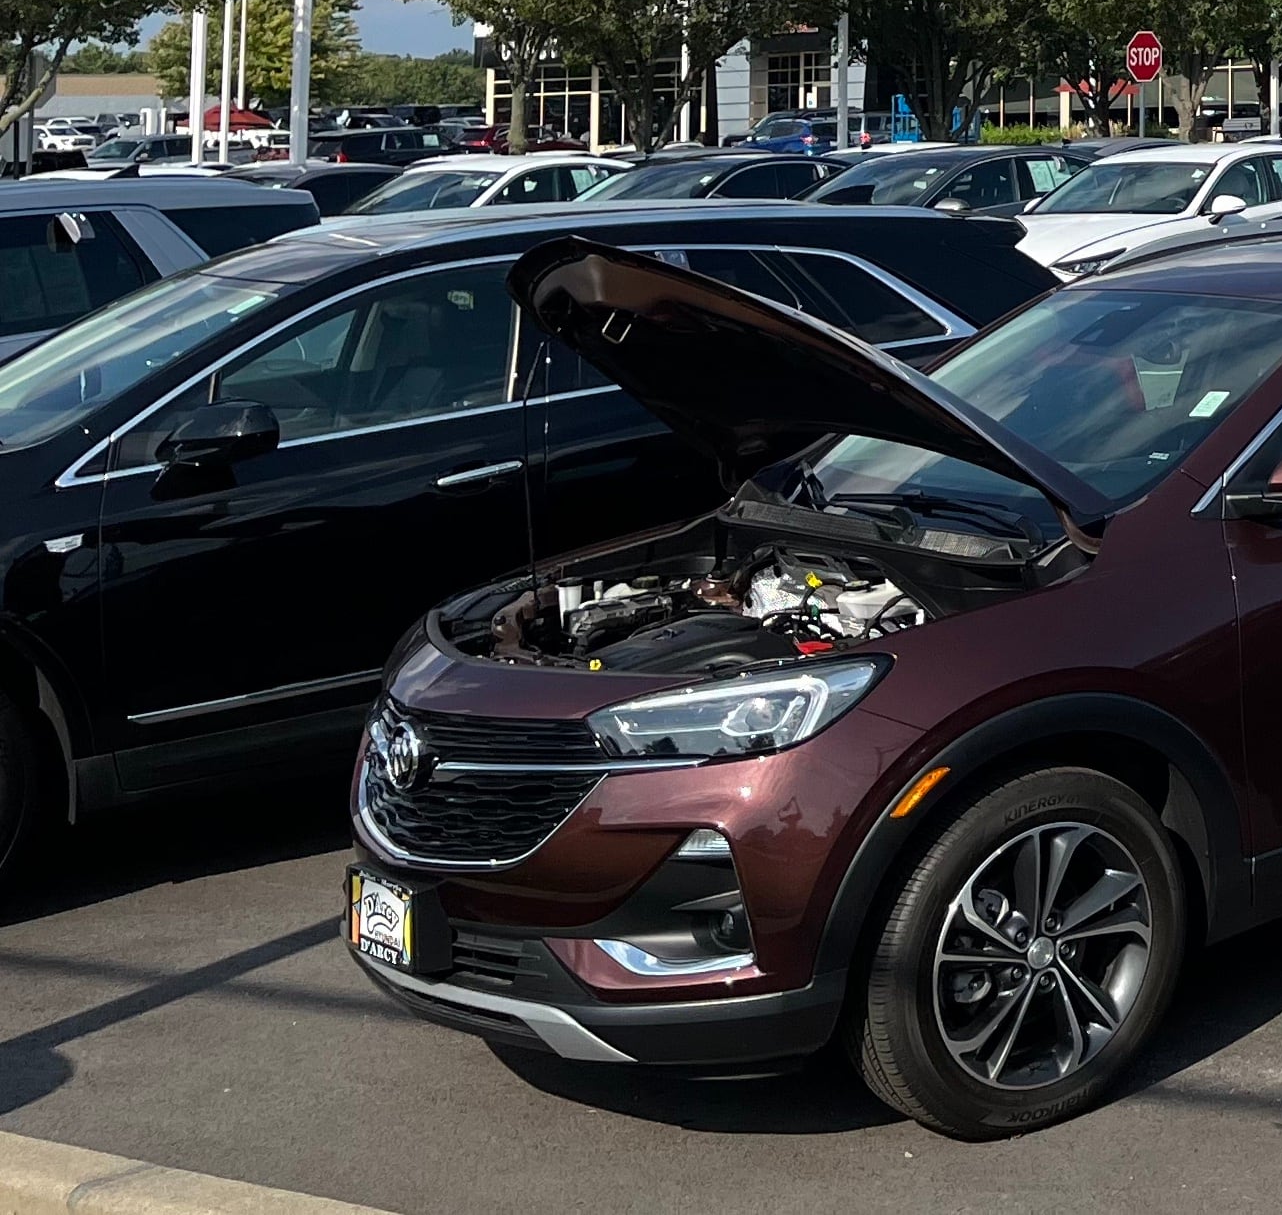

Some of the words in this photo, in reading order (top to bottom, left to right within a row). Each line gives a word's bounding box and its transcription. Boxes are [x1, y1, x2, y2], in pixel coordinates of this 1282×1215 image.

[1130, 47, 1160, 66] STOP
[364, 892, 399, 924] D'Arcy
[360, 937, 398, 965] D'ARCY
